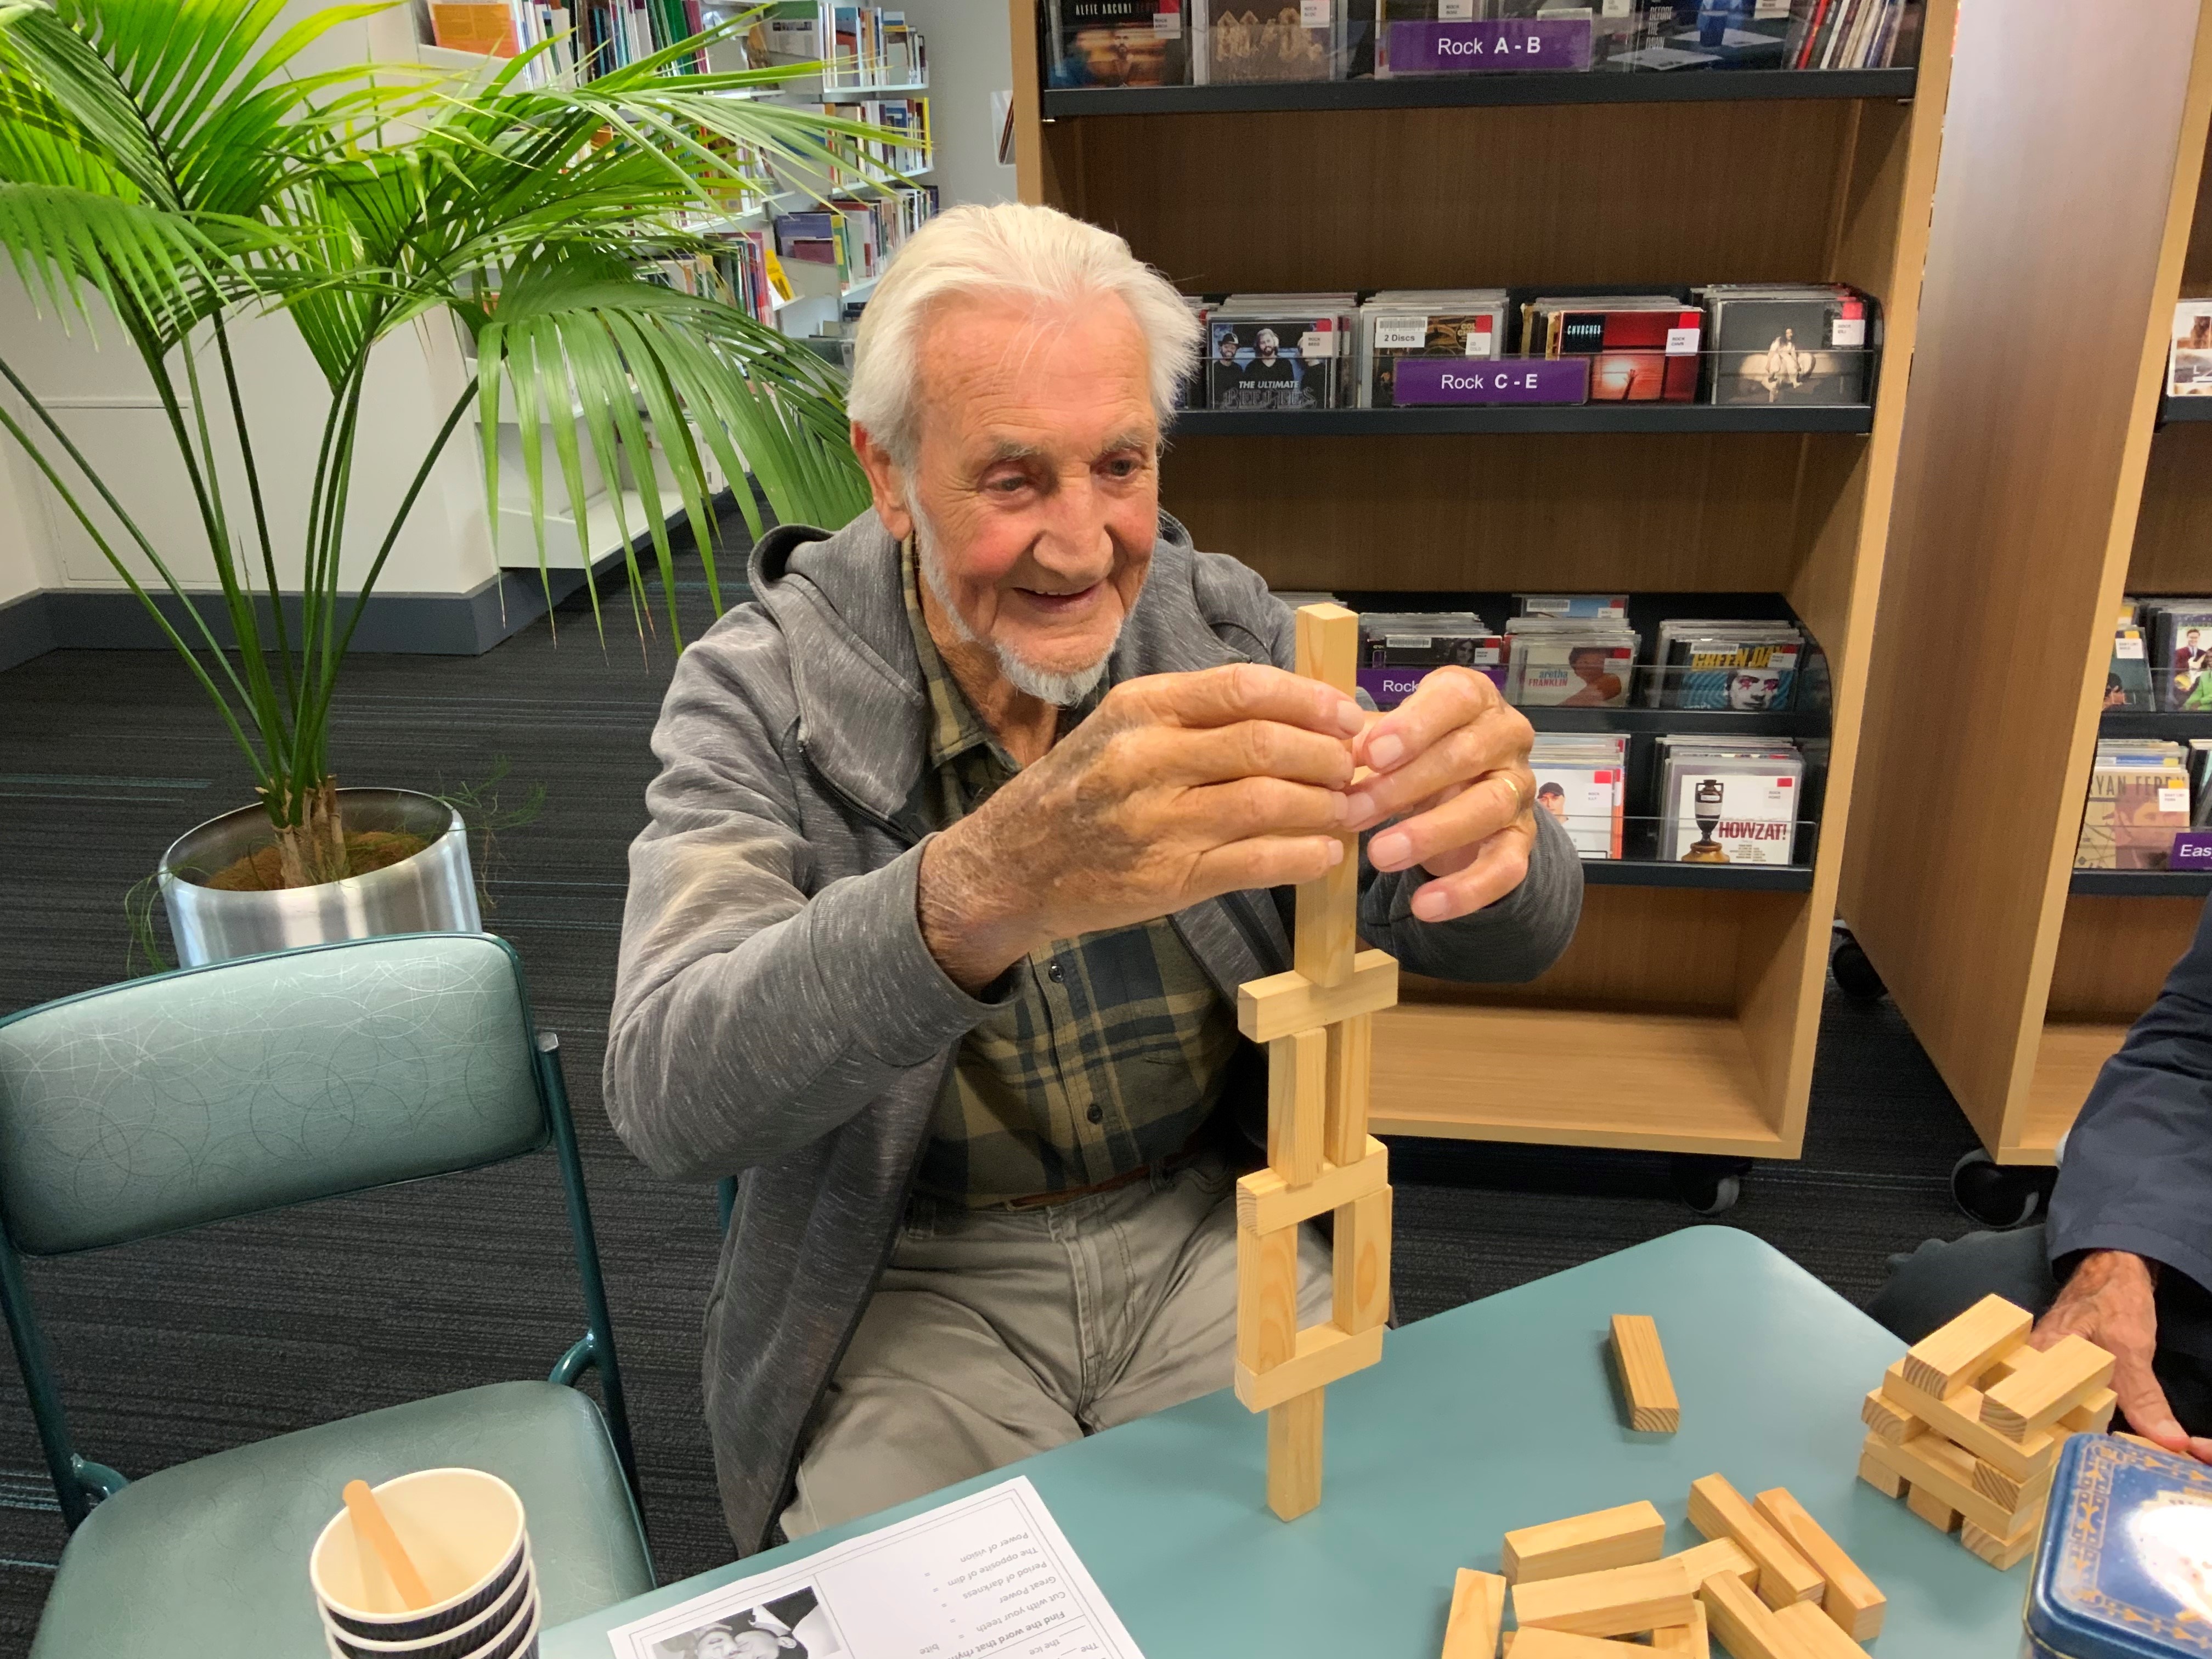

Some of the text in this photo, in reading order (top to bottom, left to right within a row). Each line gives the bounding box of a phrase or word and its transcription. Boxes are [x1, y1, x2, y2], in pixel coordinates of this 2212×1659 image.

[1076, 4, 1098, 15] ALFIE
[1102, 3, 1132, 14] ARCURI
[1650, 7, 1673, 20] BEFORE
[1647, 21, 1658, 35] THE
[1438, 37, 1483, 55] Rock
[1494, 37, 1509, 54] A
[1527, 36, 1541, 54] B
[1646, 37, 1666, 49] DAWN
[1391, 334, 1415, 342] Discs
[1239, 380, 1300, 389] THE ULTIMATE
[1441, 374, 1483, 390] Rock
[1494, 374, 1508, 389] C
[1525, 374, 1538, 388] E
[1539, 669, 1568, 678] aretha
[1383, 680, 1420, 692] Rock
[1528, 678, 1568, 687] FRANKLIN
[1718, 821, 1787, 840] HOWZAT!
[2180, 844, 2212, 860] Eas
[1000, 1532, 1029, 1547] Power
[960, 1549, 987, 1562] vision
[988, 1544, 997, 1554] of
[1020, 1547, 1039, 1556] The
[979, 1553, 1018, 1573] opposite
[1017, 1561, 1047, 1577] Period
[948, 1573, 966, 1586] dim
[968, 1571, 978, 1580] of
[1006, 1573, 1015, 1583] of
[963, 1578, 1004, 1599] darkness
[1029, 1576, 1056, 1590] Great
[1000, 1587, 1029, 1603] Power
[1048, 1591, 1065, 1601] Cut
[1026, 1599, 1048, 1611] with
[1005, 1606, 1026, 1621] your
[1043, 1611, 1065, 1625] Find
[976, 1618, 1003, 1632] teeth
[1025, 1621, 1043, 1631] the
[998, 1628, 1024, 1644] word
[919, 1643, 940, 1655] bite
[975, 1639, 997, 1652] that
[1029, 1639, 1060, 1655] the Ice
[1080, 1643, 1099, 1652] The
